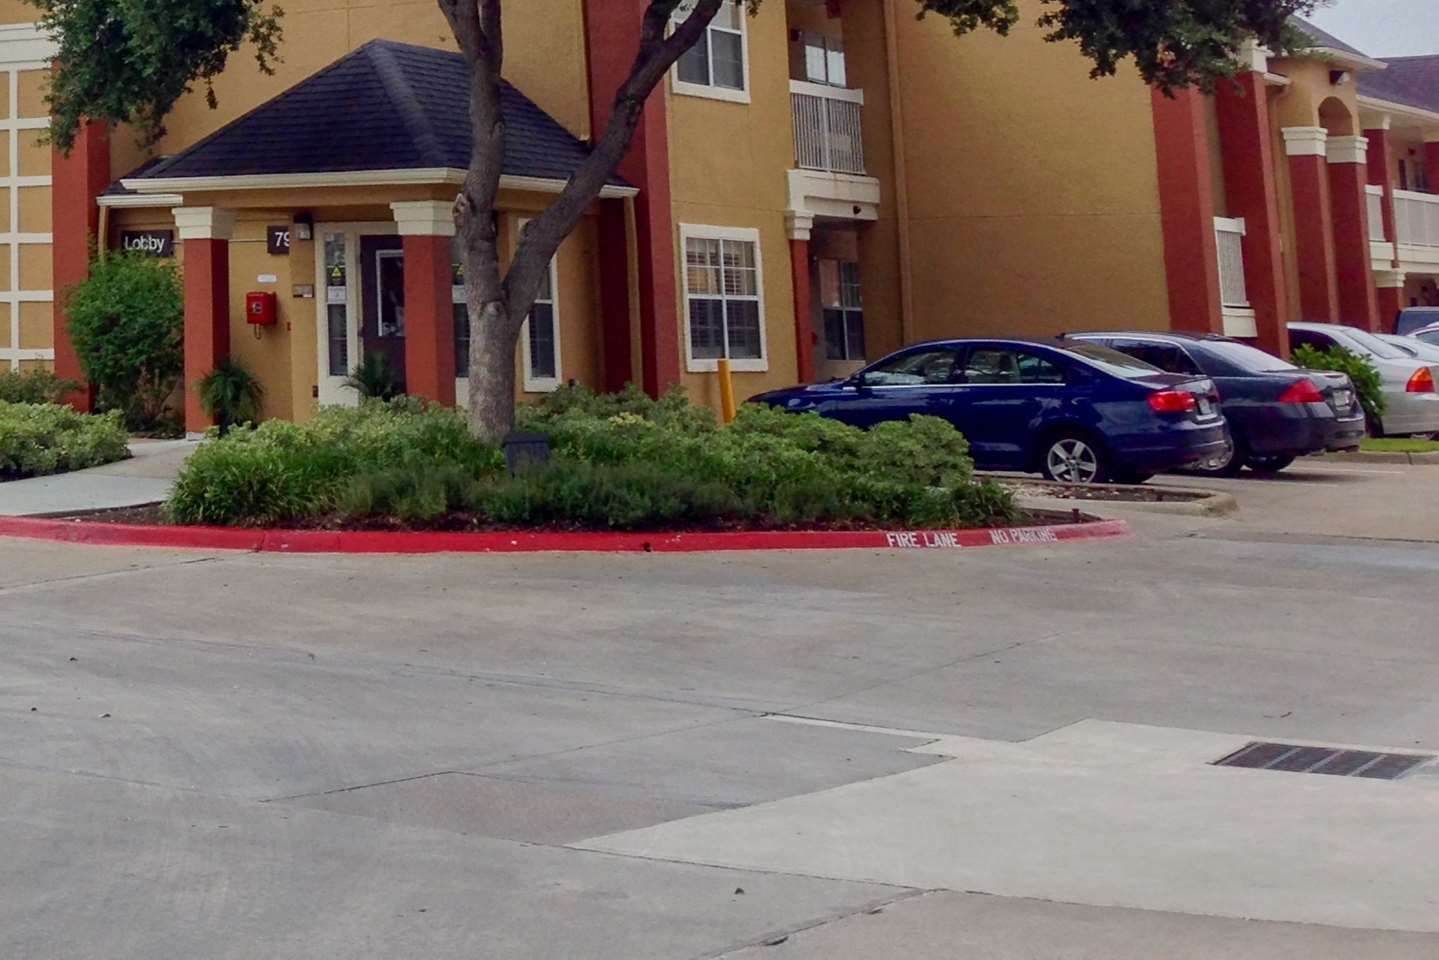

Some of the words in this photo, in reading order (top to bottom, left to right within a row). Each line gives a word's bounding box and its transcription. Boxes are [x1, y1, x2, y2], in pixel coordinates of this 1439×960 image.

[124, 235, 166, 253] Lobby
[885, 533, 918, 548] FIRE
[924, 532, 962, 548] LANE
[990, 530, 1009, 544] NO
[1011, 527, 1058, 544] PARKING
